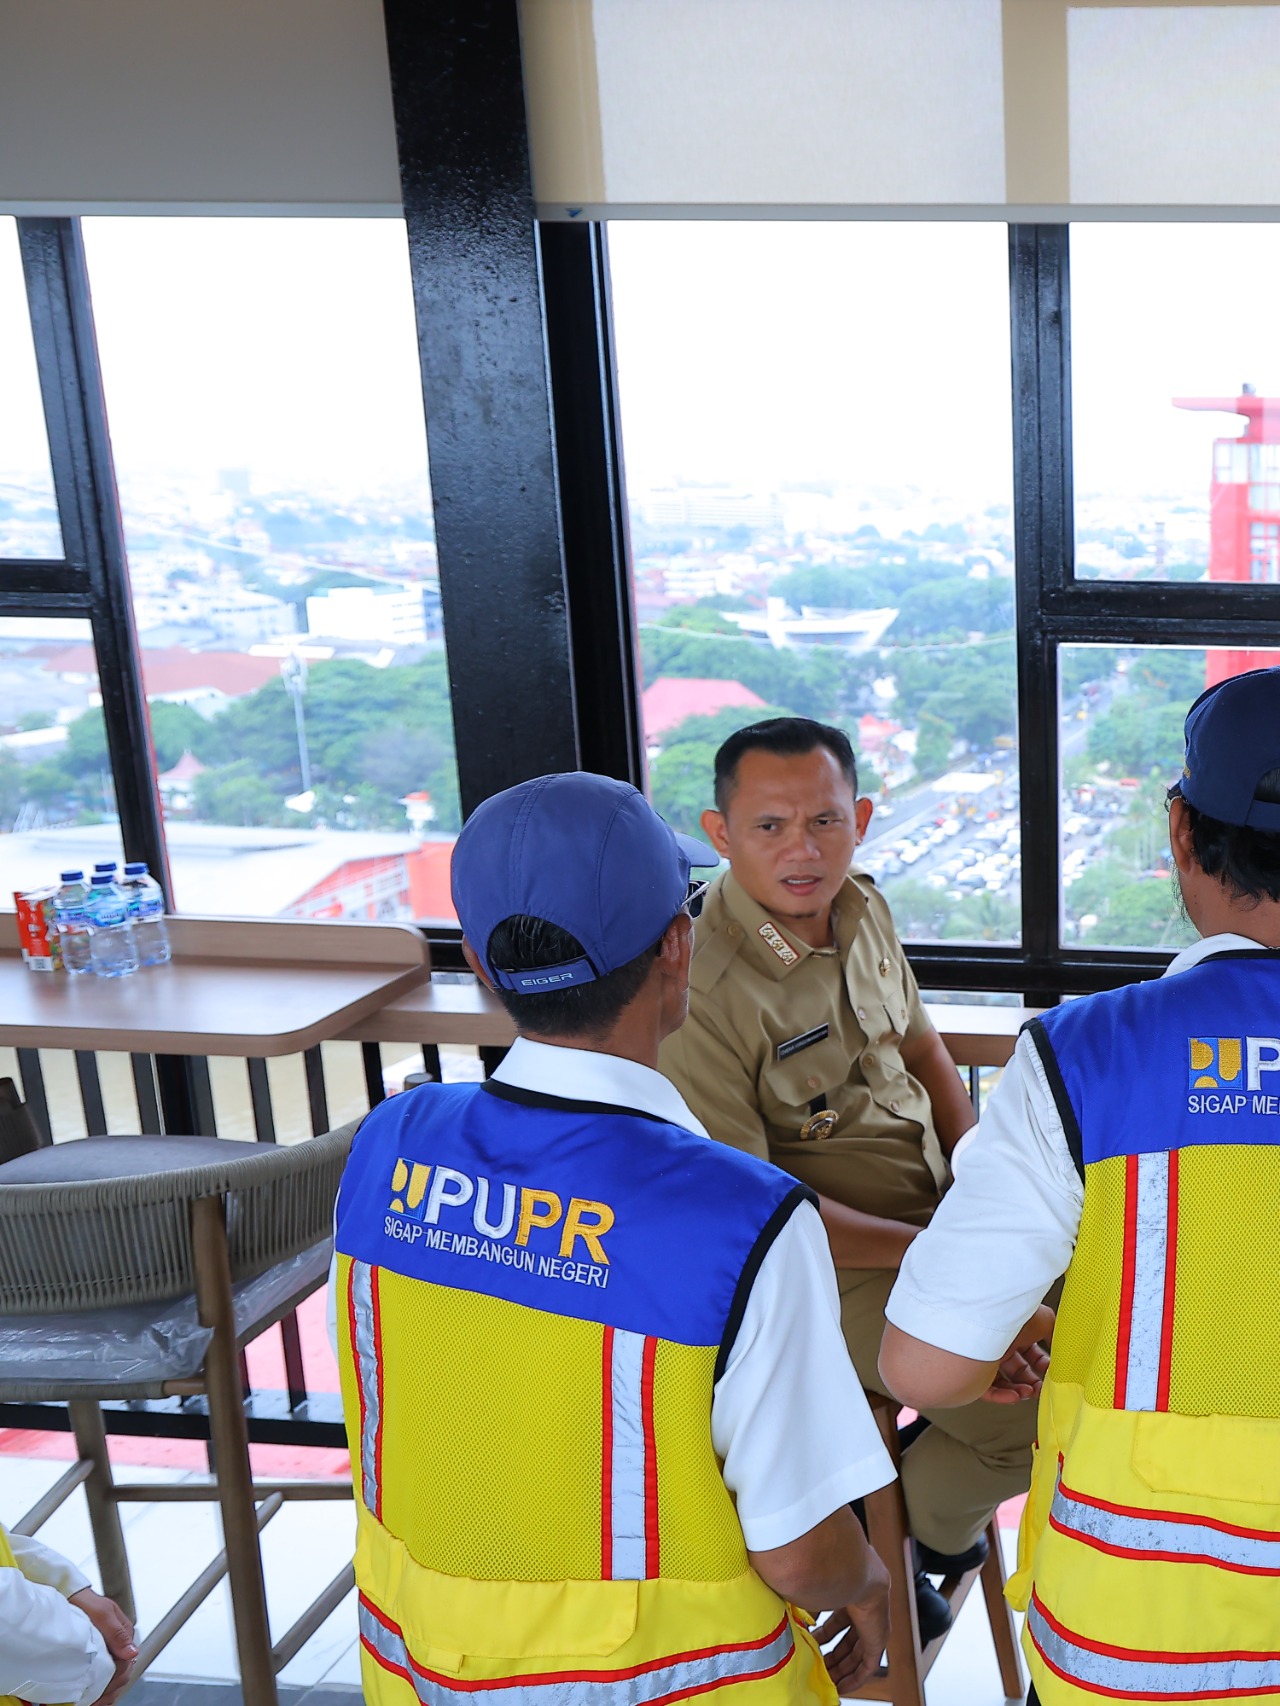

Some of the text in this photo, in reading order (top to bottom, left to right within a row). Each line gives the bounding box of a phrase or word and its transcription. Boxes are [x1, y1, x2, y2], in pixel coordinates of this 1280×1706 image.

[521, 972, 574, 986] EIGER
[1188, 1095, 1247, 1114] SIGAP
[424, 1165, 615, 1265] PUPR
[384, 1216, 609, 1289] SIGAP MEMBANGUN NEGERI
